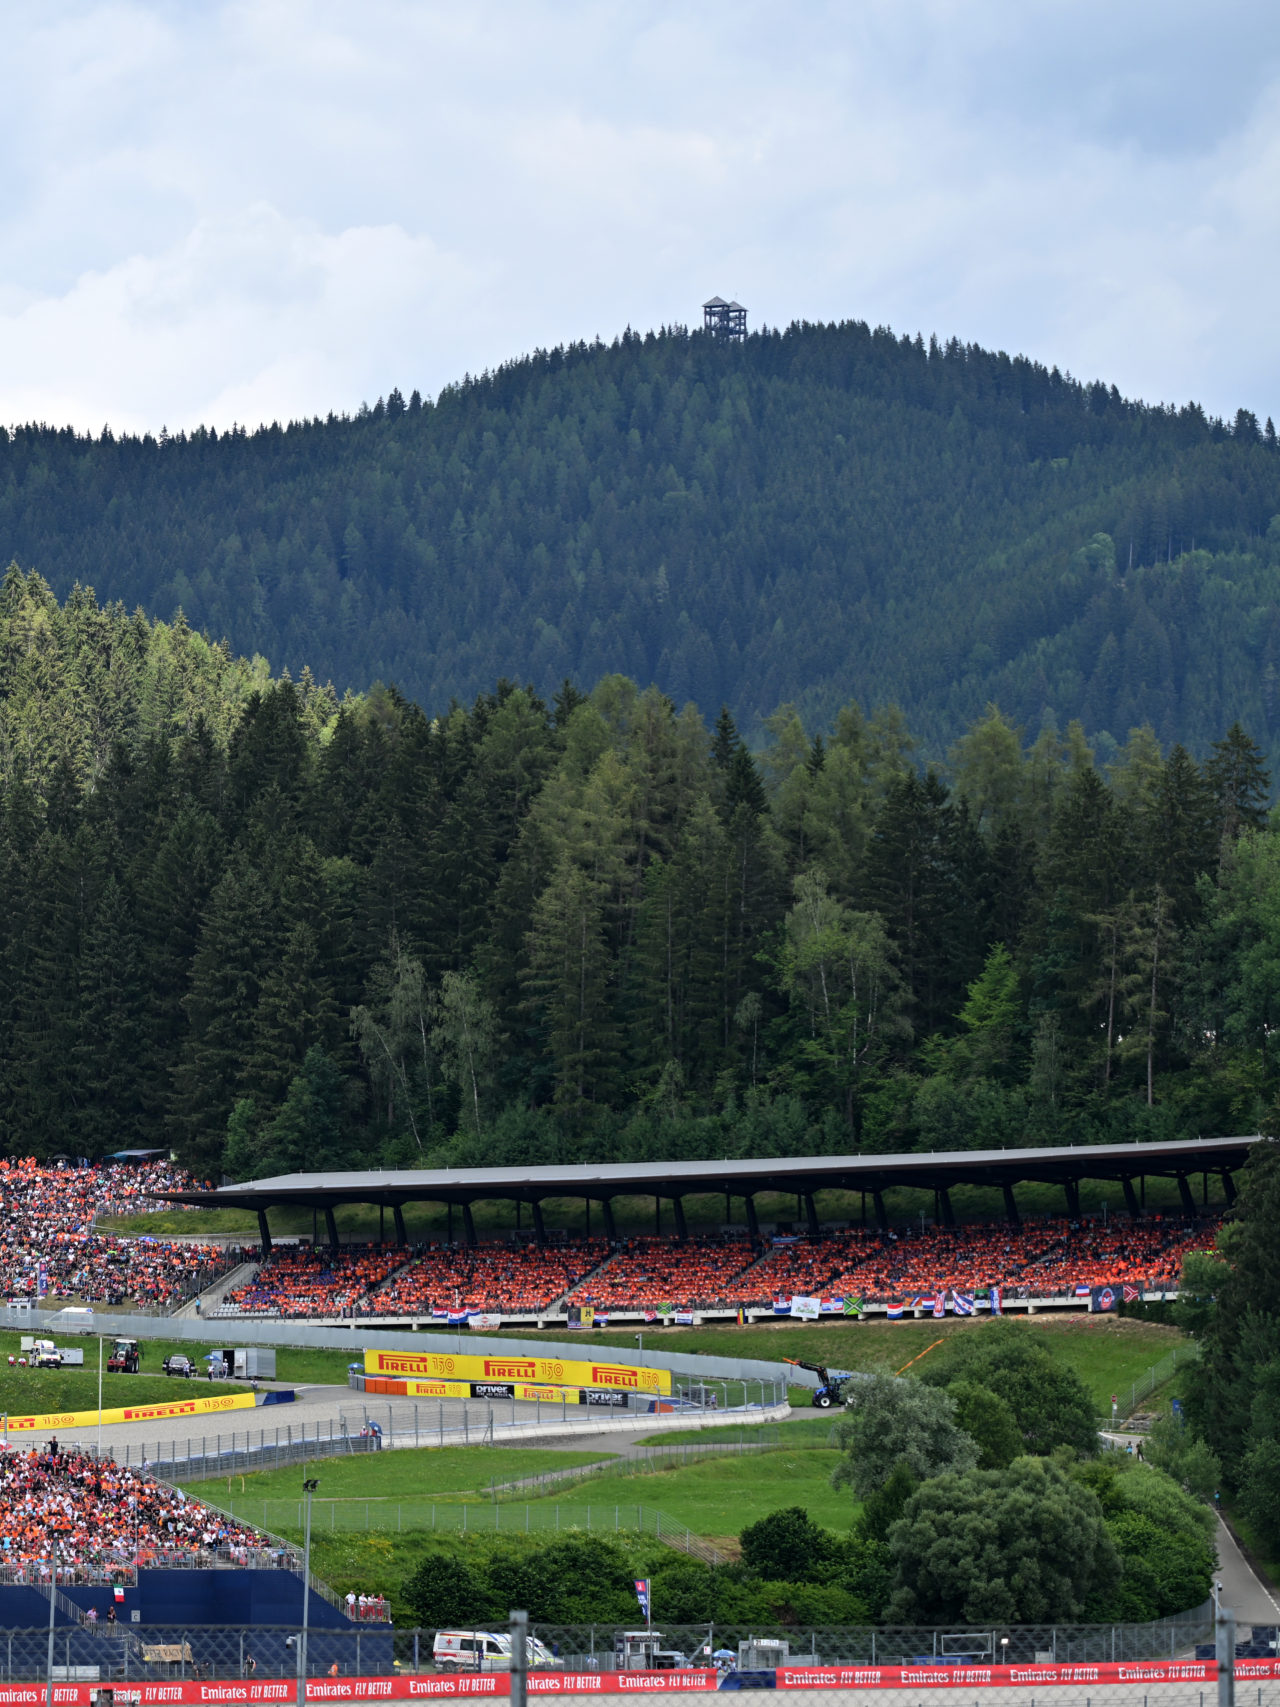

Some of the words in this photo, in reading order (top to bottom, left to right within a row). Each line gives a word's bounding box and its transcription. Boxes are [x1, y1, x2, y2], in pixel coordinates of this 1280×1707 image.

[378, 1354, 427, 1373] PIRELLI
[432, 1357, 455, 1374] 150
[484, 1360, 536, 1378] PIRELLI
[541, 1362, 564, 1380] 150
[592, 1366, 638, 1387] PIRELLI
[642, 1371, 660, 1389] 150
[416, 1384, 446, 1395] PIRELLI
[523, 1387, 554, 1400] PIRELLI
[124, 1402, 195, 1419] PIRELLI
[785, 1672, 836, 1684] Emirates
[840, 1672, 853, 1684] FLY
[854, 1671, 881, 1684] BETTER
[900, 1671, 949, 1684] Emirates
[952, 1671, 965, 1683] FLY
[965, 1670, 991, 1682] BETTER
[1010, 1669, 1057, 1682] Emirates
[1060, 1669, 1073, 1681] FLY
[1073, 1668, 1099, 1680] BETTER
[1118, 1667, 1165, 1680] Emirates
[1168, 1667, 1180, 1679] FLY
[1181, 1665, 1206, 1678] BETTER
[1233, 1664, 1270, 1677] mirates
[409, 1680, 455, 1694] Emirates
[458, 1679, 470, 1692] FLY
[471, 1678, 496, 1691] BETTER
[526, 1677, 560, 1690] mirates
[563, 1677, 576, 1689] FLY
[576, 1676, 601, 1689] BETTER
[618, 1675, 665, 1688] Emirates
[668, 1674, 681, 1686] FLY
[682, 1674, 706, 1686] BETTER
[53, 1688, 78, 1702] BETTER
[145, 1688, 157, 1700] FLY
[158, 1687, 183, 1700] BETTER
[201, 1686, 247, 1699] Emirates
[250, 1686, 262, 1699] FLY
[263, 1685, 288, 1698] BETTER
[306, 1683, 351, 1697] Emirates
[355, 1683, 367, 1695] FLY
[367, 1682, 392, 1695] BETTER
